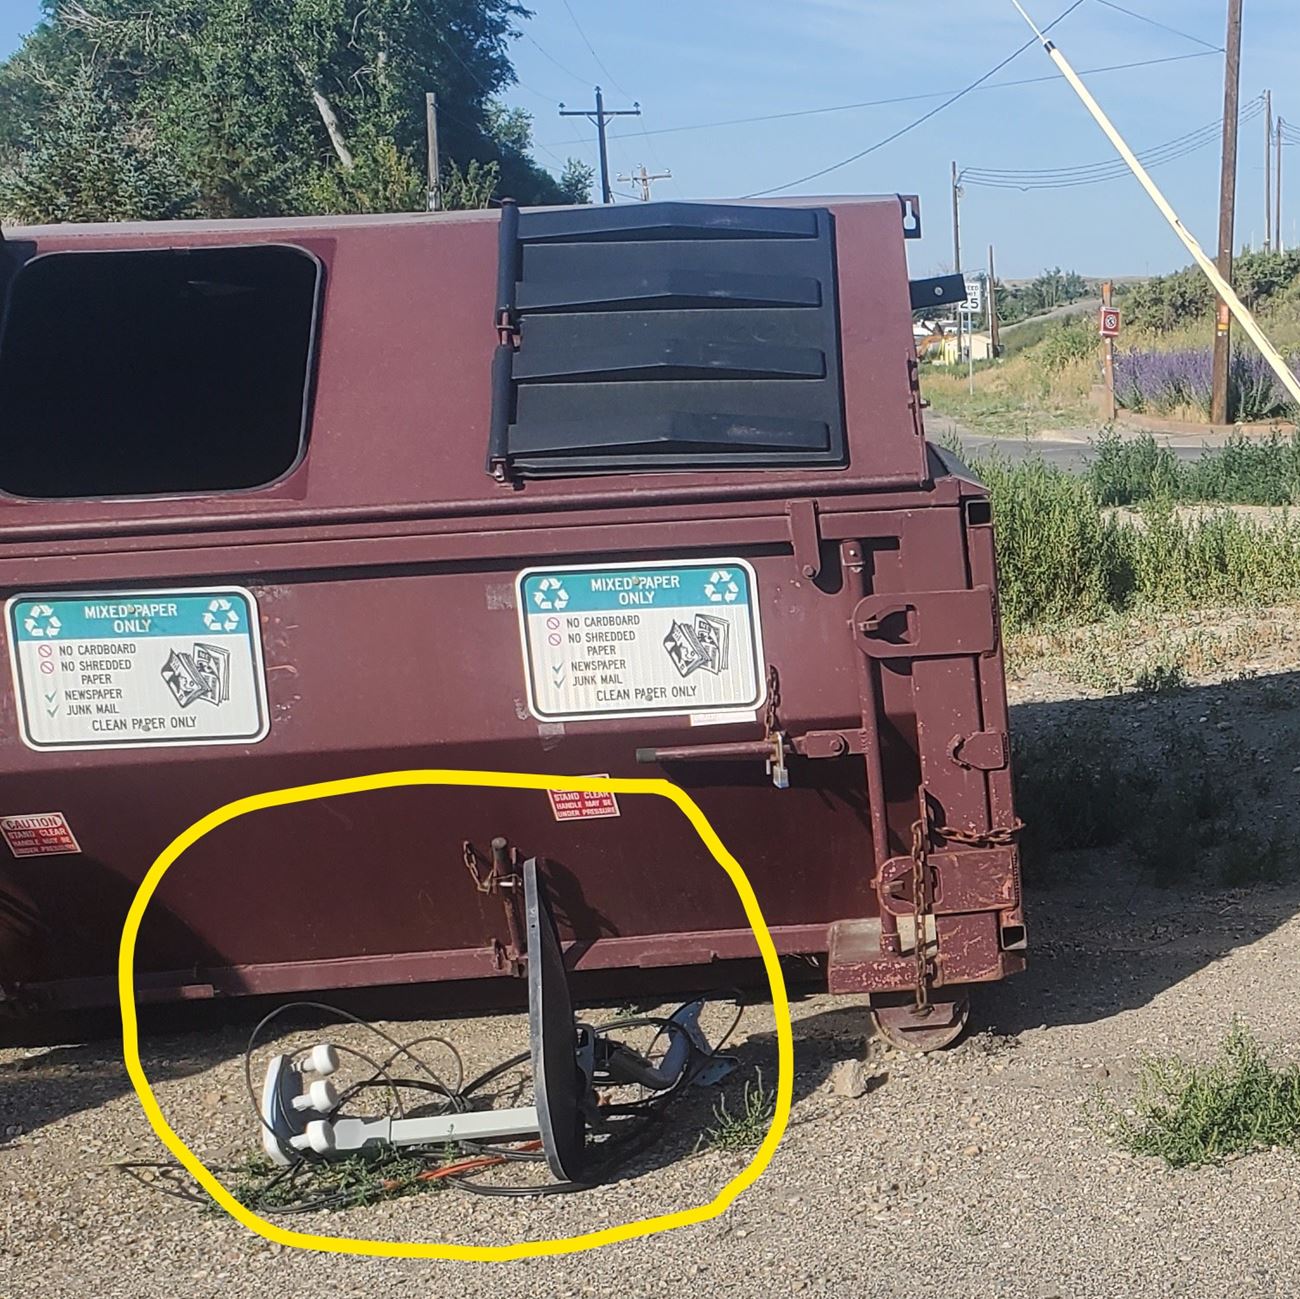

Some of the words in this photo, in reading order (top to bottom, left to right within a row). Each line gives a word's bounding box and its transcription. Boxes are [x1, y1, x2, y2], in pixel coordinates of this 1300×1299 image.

[960, 298, 979, 309] 25
[591, 577, 632, 591] MIXED
[638, 575, 680, 589] PAPER
[619, 591, 655, 605] ONLY
[85, 604, 127, 619] MIXED
[134, 603, 177, 617] PAPER
[113, 618, 152, 633] ONLY
[566, 619, 580, 628] NO
[584, 615, 640, 627] CARDBOARD
[568, 634, 581, 643] NO
[585, 630, 636, 642] SHREDDED
[59, 646, 74, 656] NO
[77, 643, 136, 656] CARDBOARD
[587, 645, 616, 656] PAPER
[61, 662, 75, 672] NO
[79, 659, 132, 671] SHREDDED
[571, 659, 627, 672] NEWSPAPER
[81, 674, 112, 685] PAPER
[573, 676, 597, 686] JUNK
[600, 675, 623, 685] MAIL
[65, 689, 123, 700] NEWSPAPER
[596, 690, 630, 702] CLEAN
[634, 689, 667, 700] PAPER
[671, 685, 697, 698] ONLY
[67, 705, 92, 716] JUNK
[96, 704, 120, 714] MAIL
[92, 720, 127, 731] CLEAN
[132, 718, 166, 730] PAPER
[170, 716, 197, 728] ONLY
[554, 793, 580, 801] STAND
[6, 817, 58, 829] CAUTION
[39, 828, 67, 837] CLEAR
